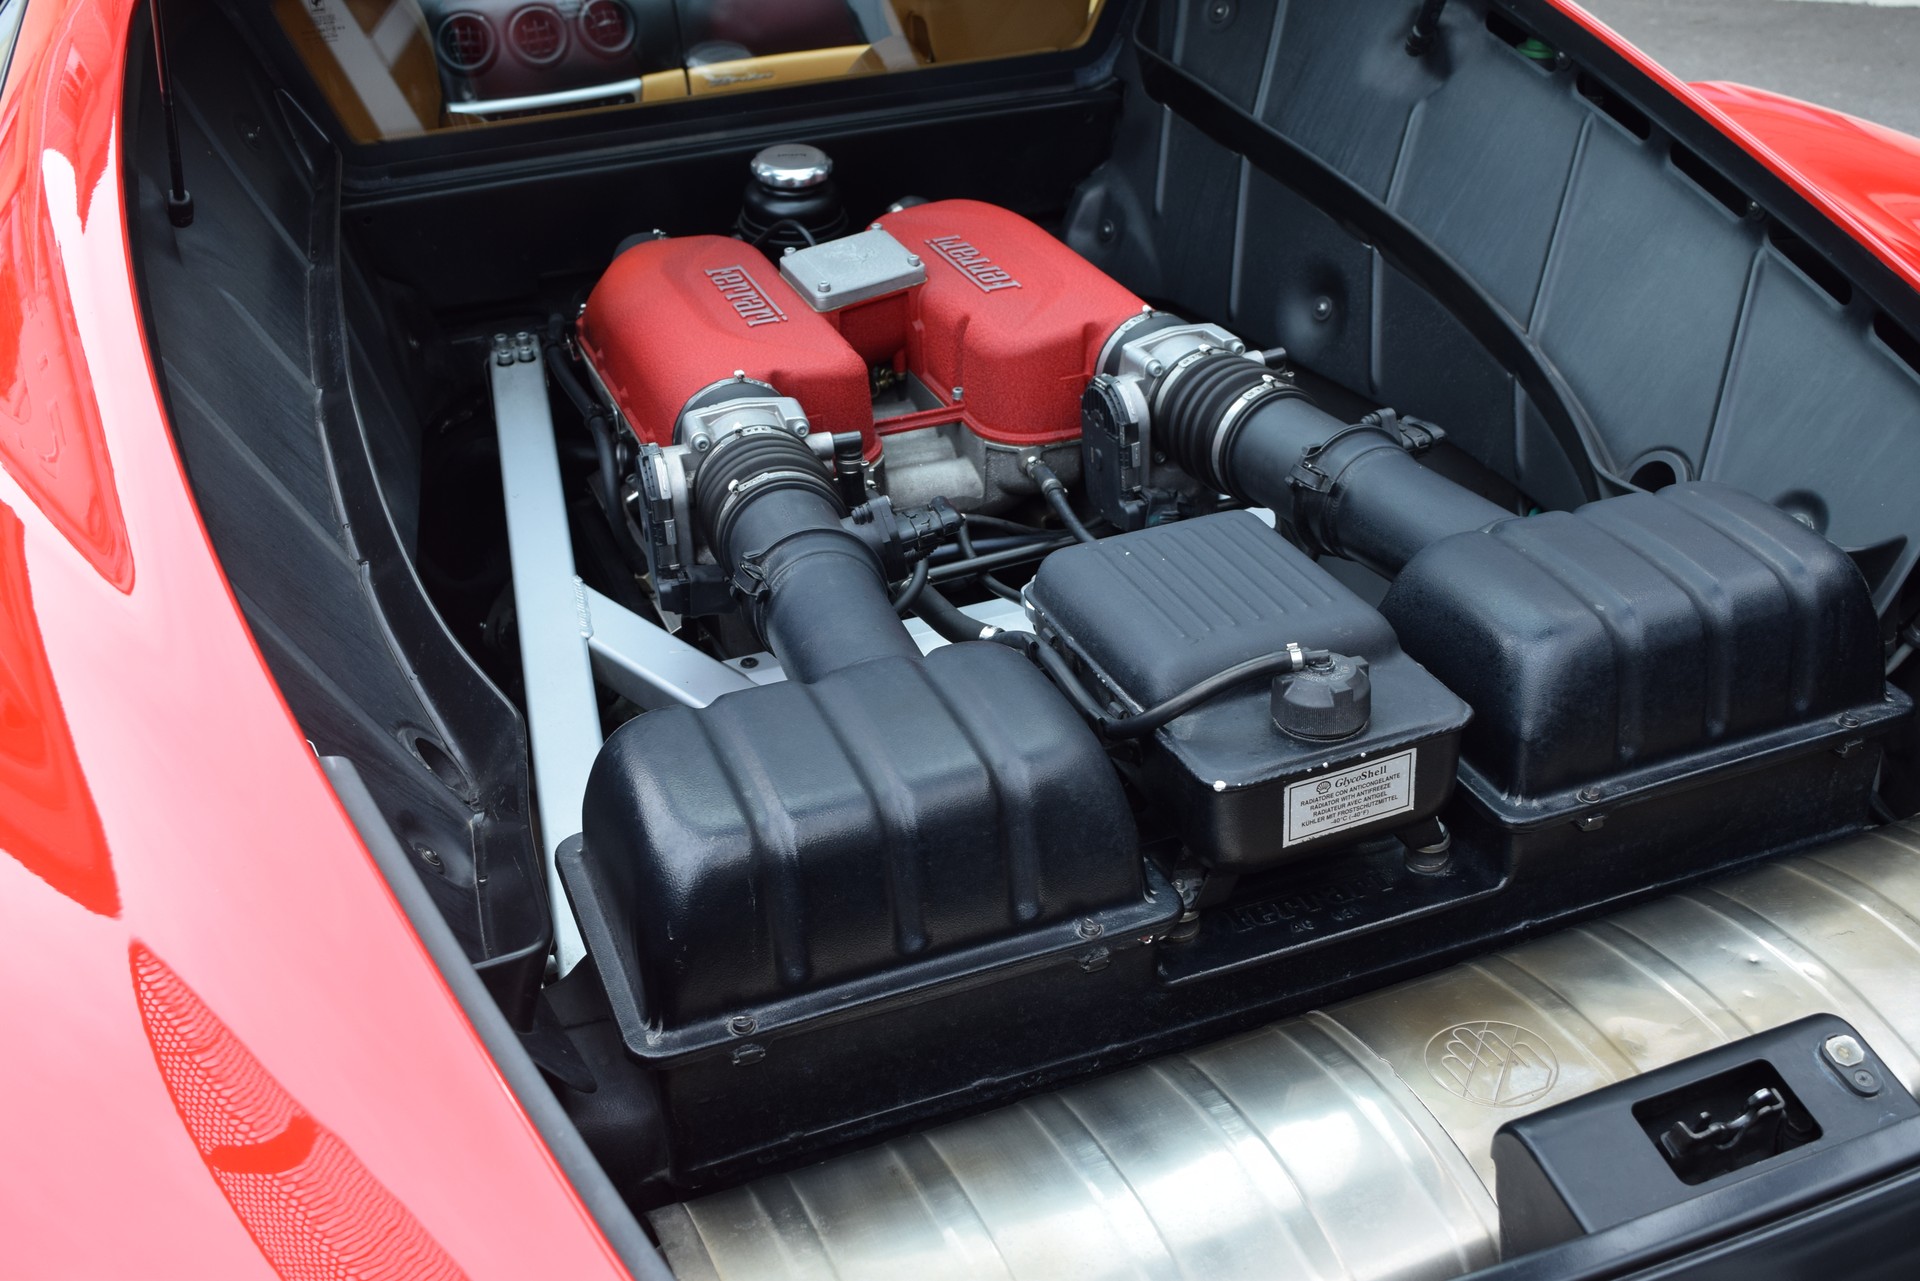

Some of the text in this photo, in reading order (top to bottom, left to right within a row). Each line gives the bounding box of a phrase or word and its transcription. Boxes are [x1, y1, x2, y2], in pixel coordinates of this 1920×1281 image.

[925, 234, 1023, 293] Ferrari
[704, 264, 788, 328] Ferrari
[1300, 773, 1401, 807] RADIATORE CON ANTICONGELANTE
[1335, 765, 1387, 788] GlycoShell
[1310, 783, 1391, 811] RADIATOR WITH ANTIFREEZE
[1313, 791, 1387, 817] RADIATEUR AVEC ANTIGEL
[1326, 811, 1336, 820] MIT
[1337, 794, 1398, 817] FROSTSCHUTZMITTEL
